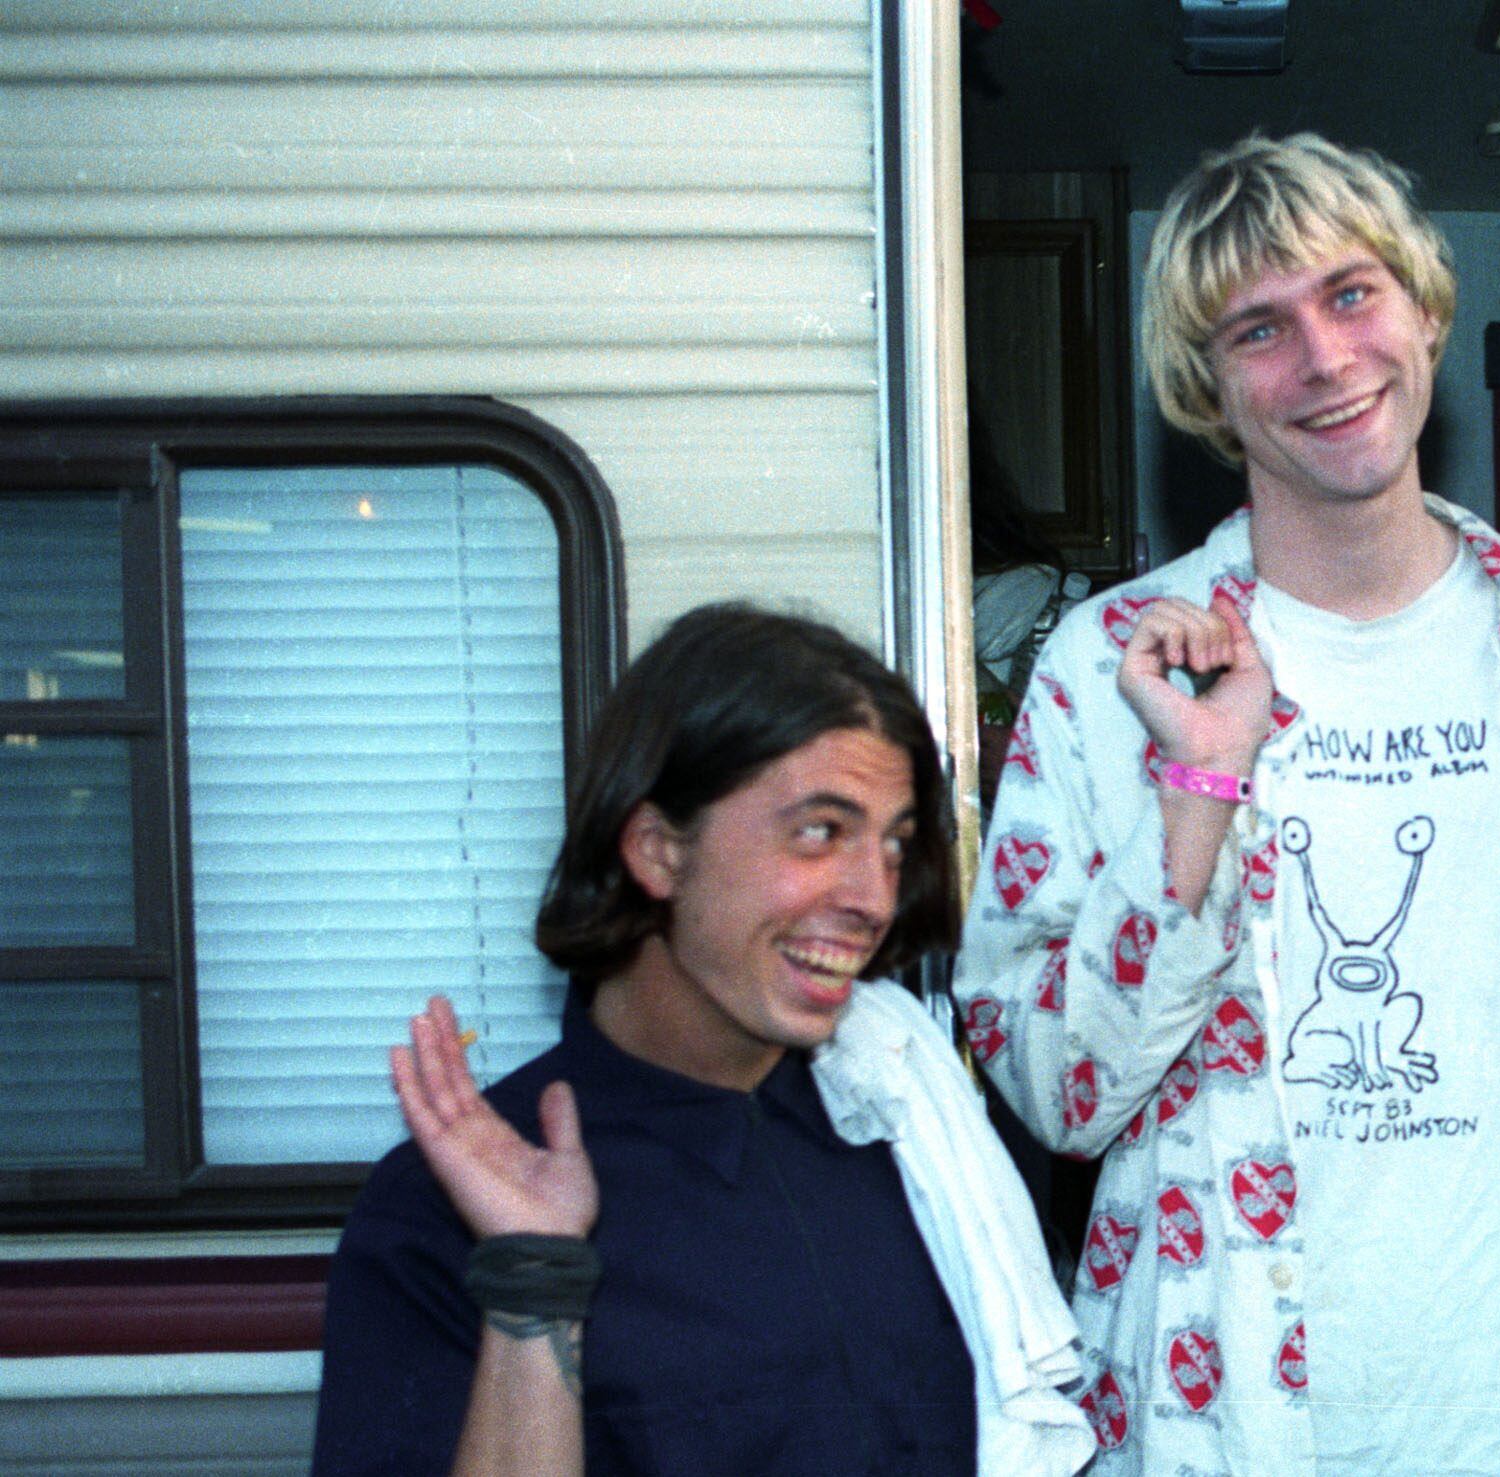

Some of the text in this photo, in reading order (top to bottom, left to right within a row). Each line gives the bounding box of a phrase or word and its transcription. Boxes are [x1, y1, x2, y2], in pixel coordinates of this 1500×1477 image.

[1304, 718, 1487, 763] HOW ARE YOU
[1430, 759, 1489, 778] ALBUM
[1326, 1097, 1413, 1120] SEPT 83
[1355, 1116, 1479, 1144] JOHNSTON
